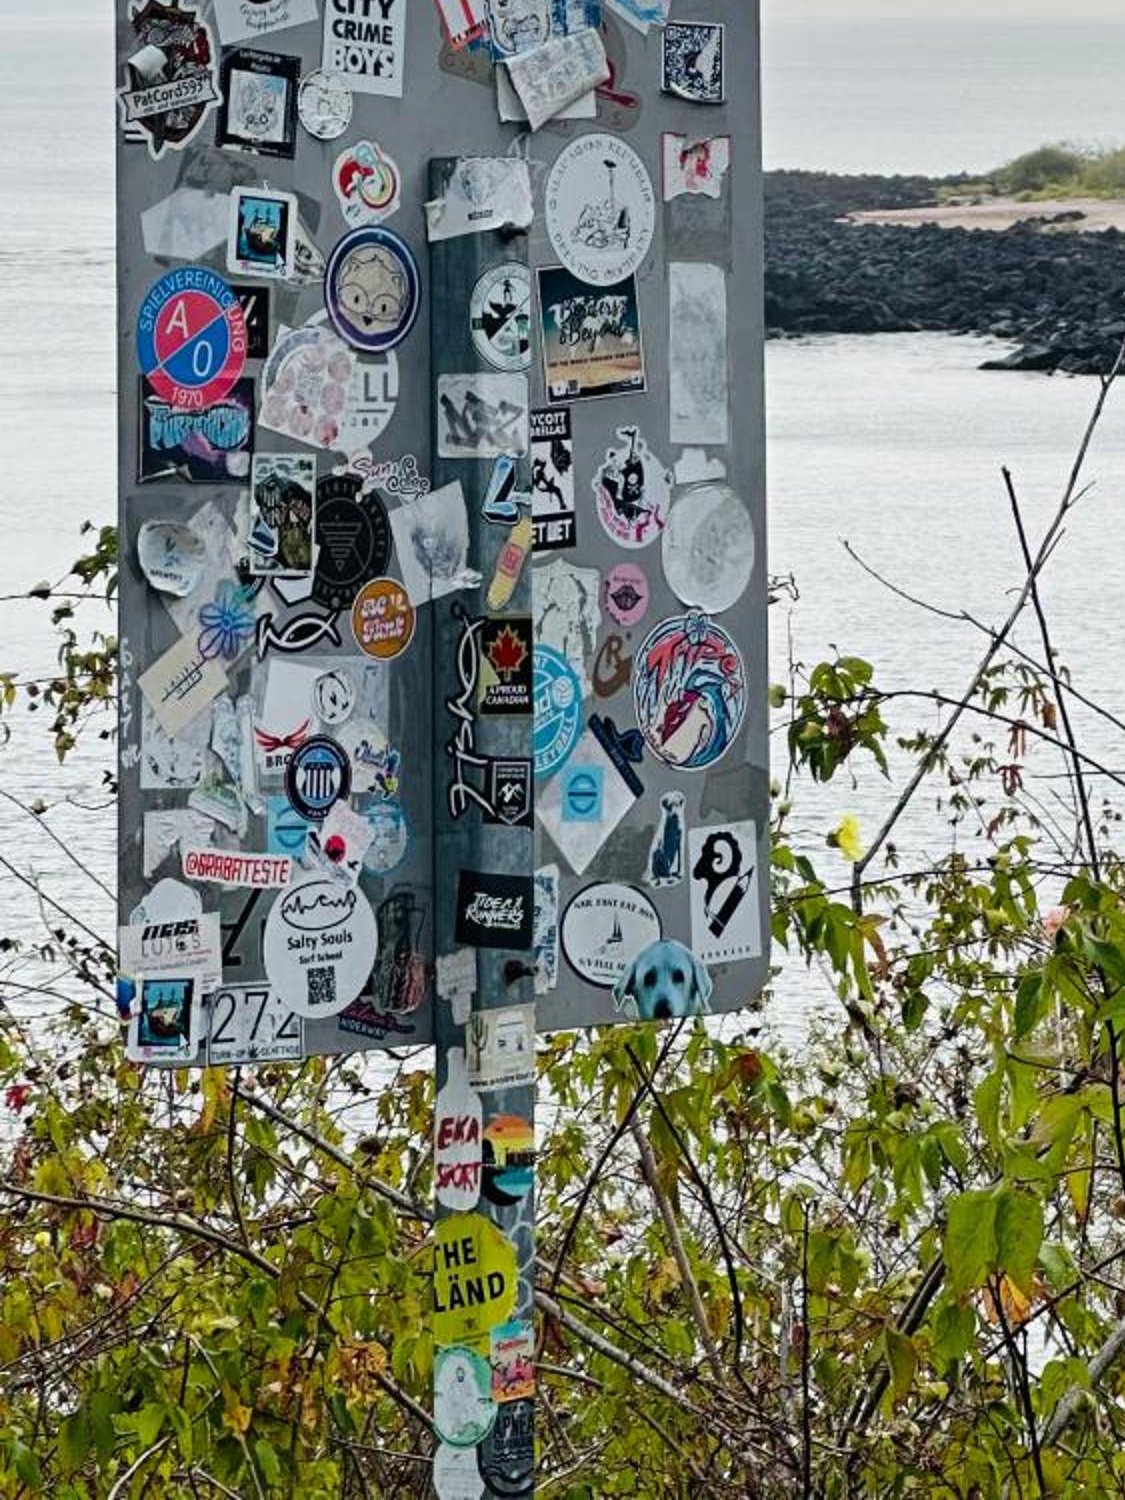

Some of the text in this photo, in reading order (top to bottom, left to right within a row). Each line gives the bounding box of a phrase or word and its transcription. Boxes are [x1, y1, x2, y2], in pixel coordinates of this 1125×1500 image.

[332, 19, 393, 45] CRIME
[334, 46, 395, 78] BOYS
[139, 270, 245, 353] SPIELVEREINIGUNG
[165, 299, 190, 339] A
[171, 386, 204, 405] 1970
[287, 929, 353, 951] Salty Souls
[437, 1115, 479, 1150] EKA
[434, 1237, 477, 1272] THE
[434, 1272, 505, 1312] LÄND
